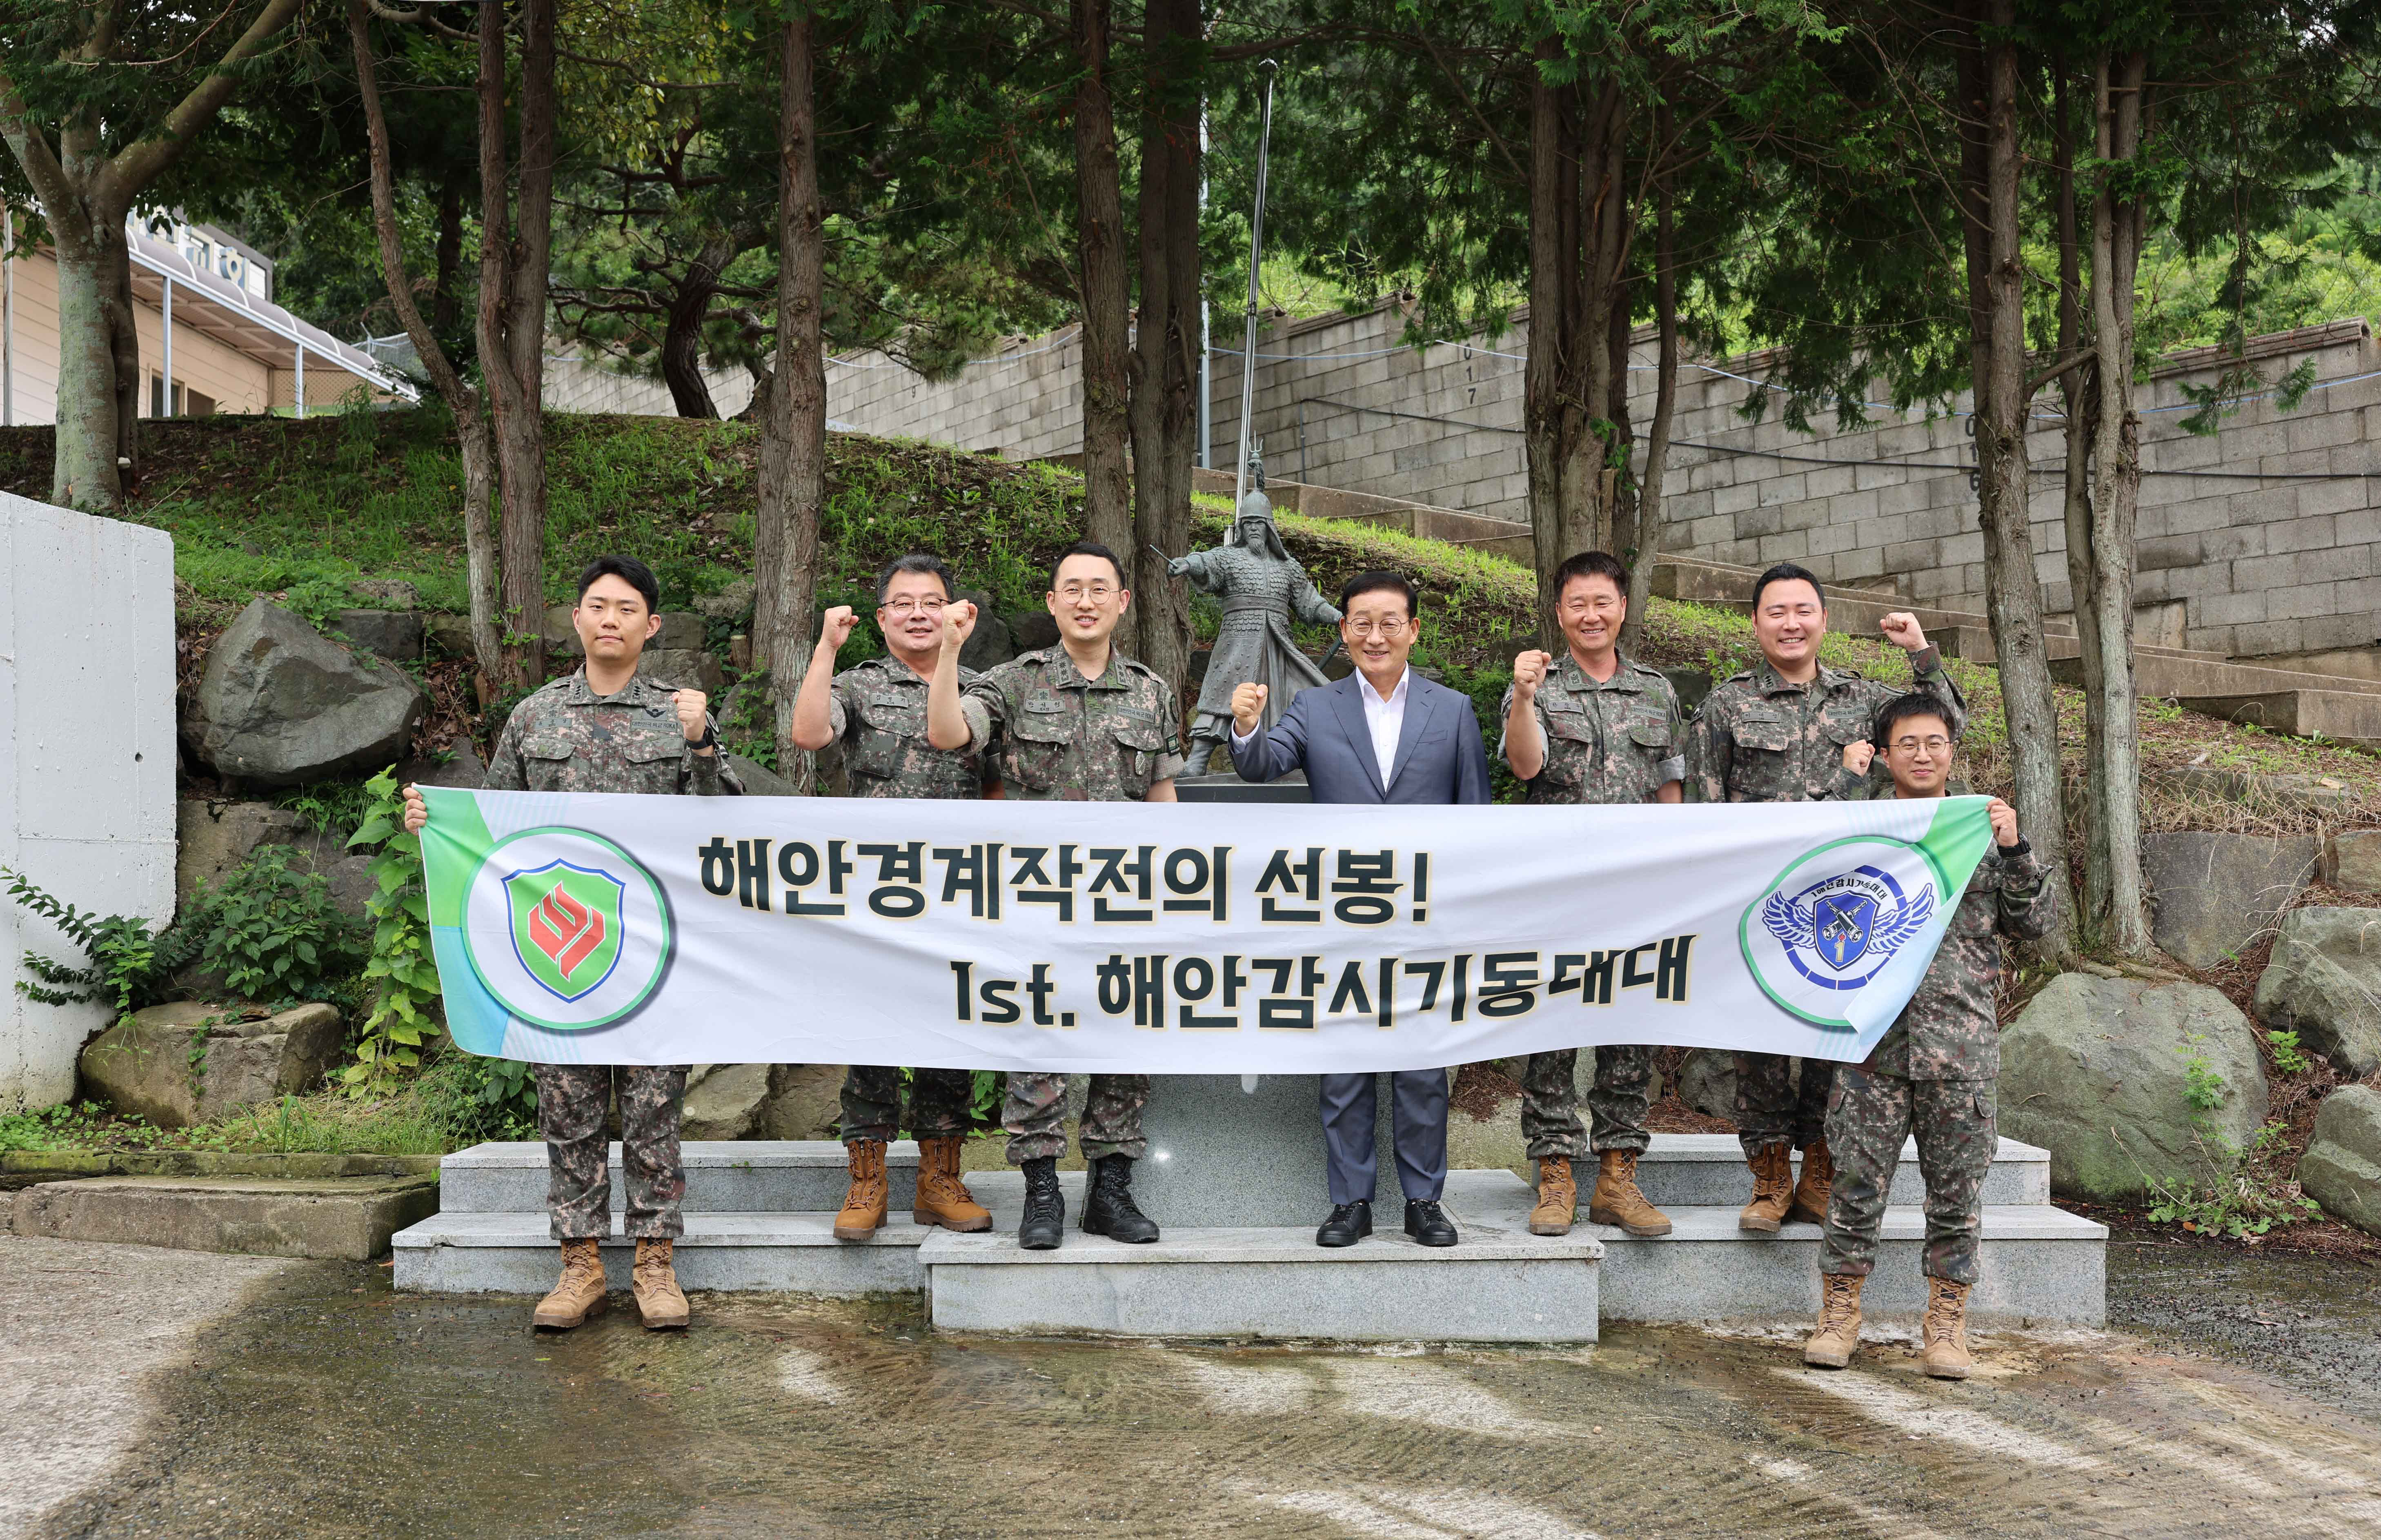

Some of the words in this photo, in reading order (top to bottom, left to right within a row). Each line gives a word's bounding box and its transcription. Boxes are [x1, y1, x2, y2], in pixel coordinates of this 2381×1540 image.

[699, 837, 1232, 921] 해안경계작전의
[1254, 847, 1429, 924] 선봉!
[950, 961, 1075, 1027] 1st.
[1097, 934, 1697, 1029] 해안감시기동대대
[1834, 941, 1845, 962] 1
